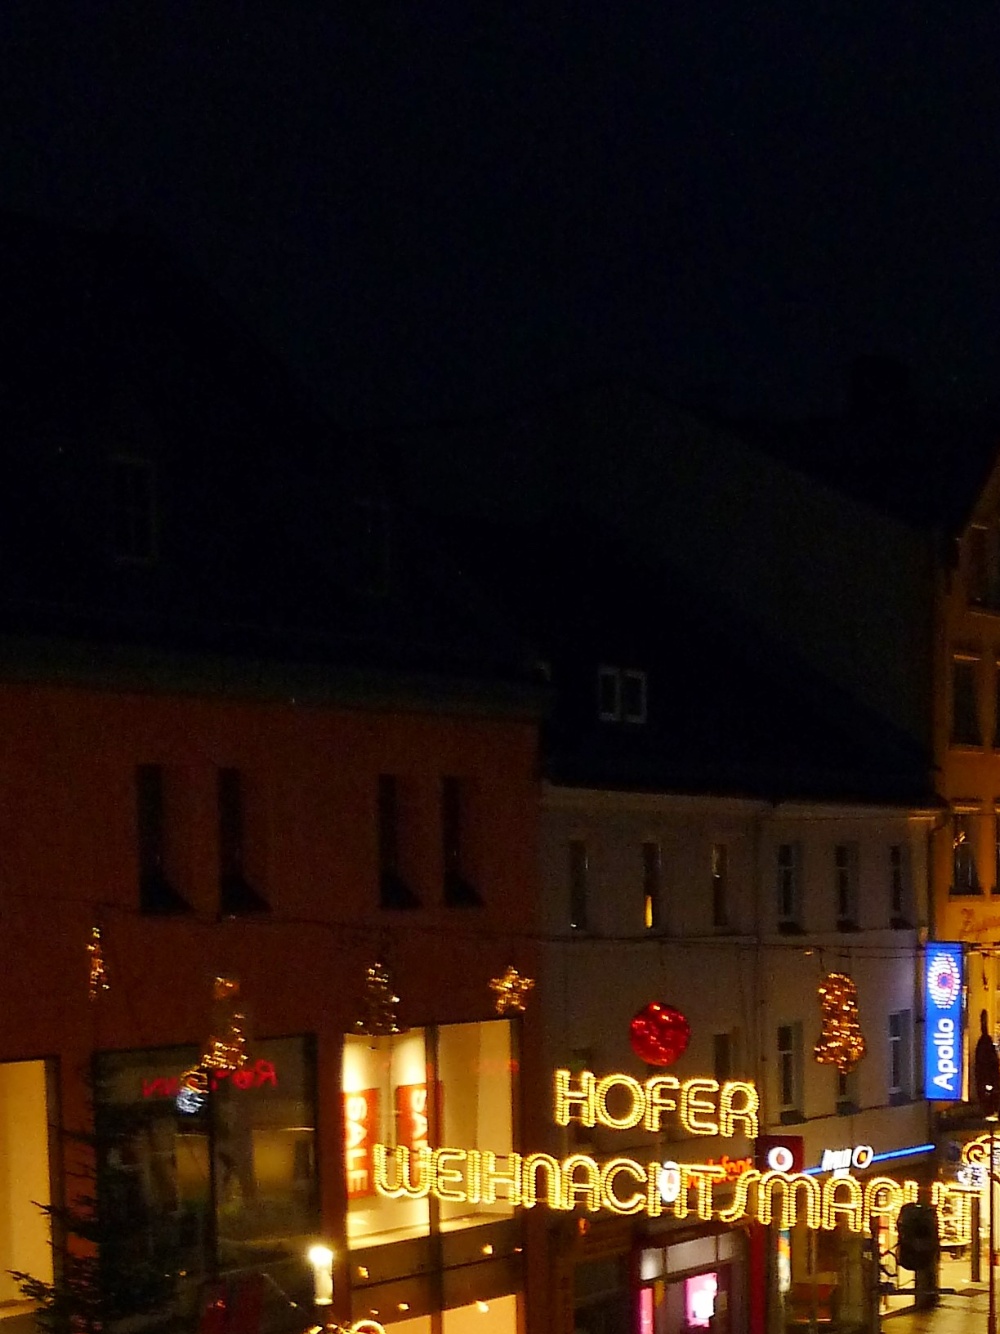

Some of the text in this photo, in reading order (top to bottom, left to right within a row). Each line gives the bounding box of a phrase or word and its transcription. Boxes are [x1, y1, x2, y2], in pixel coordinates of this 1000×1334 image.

[933, 1018, 958, 1091] Apollo
[555, 1068, 760, 1138] HOFER
[346, 1096, 368, 1193] SALE
